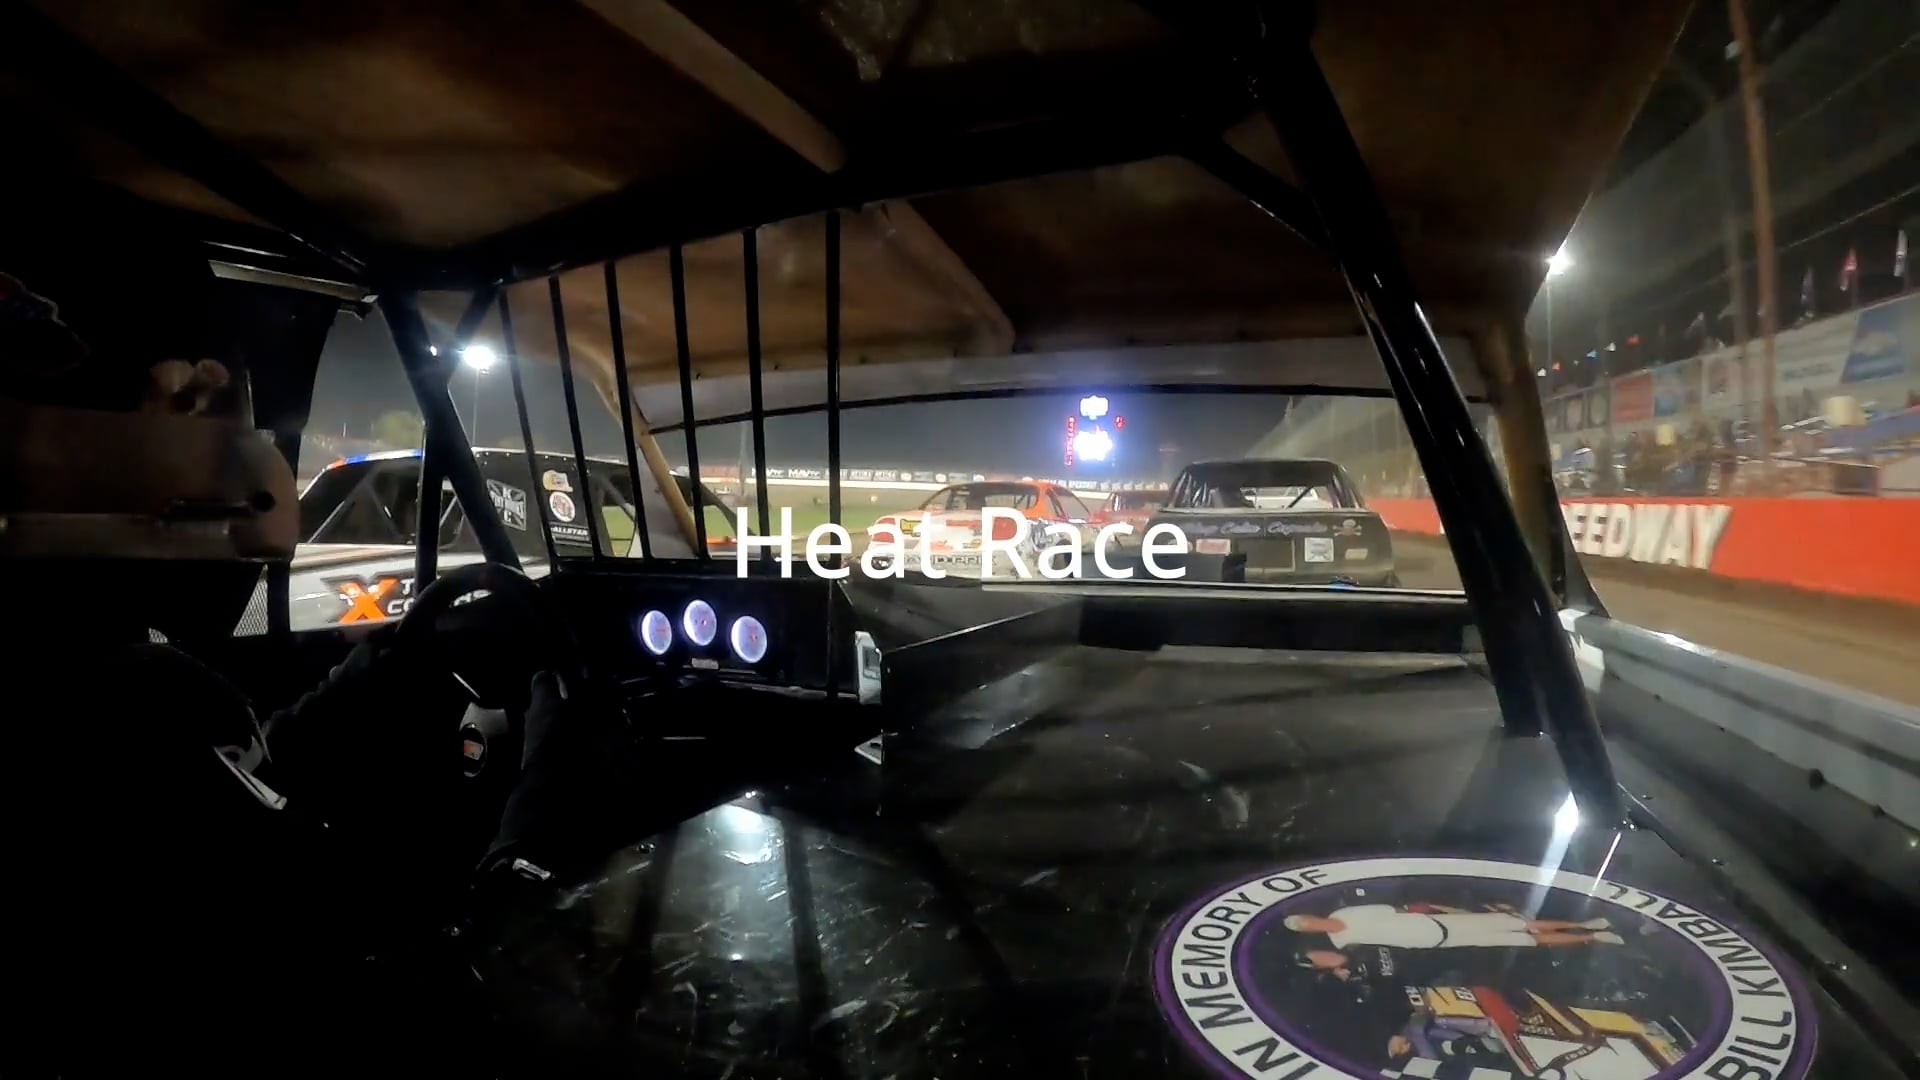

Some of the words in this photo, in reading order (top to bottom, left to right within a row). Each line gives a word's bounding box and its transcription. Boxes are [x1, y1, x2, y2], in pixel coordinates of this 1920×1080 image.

[1561, 503, 1732, 569] EEDWAY
[1262, 868, 1328, 893] OF
[1181, 892, 1263, 1030] MEMORY
[1606, 882, 1786, 997] KIMBALL
[1233, 1037, 1320, 1080] IN
[1704, 1011, 1792, 1080] BILL
